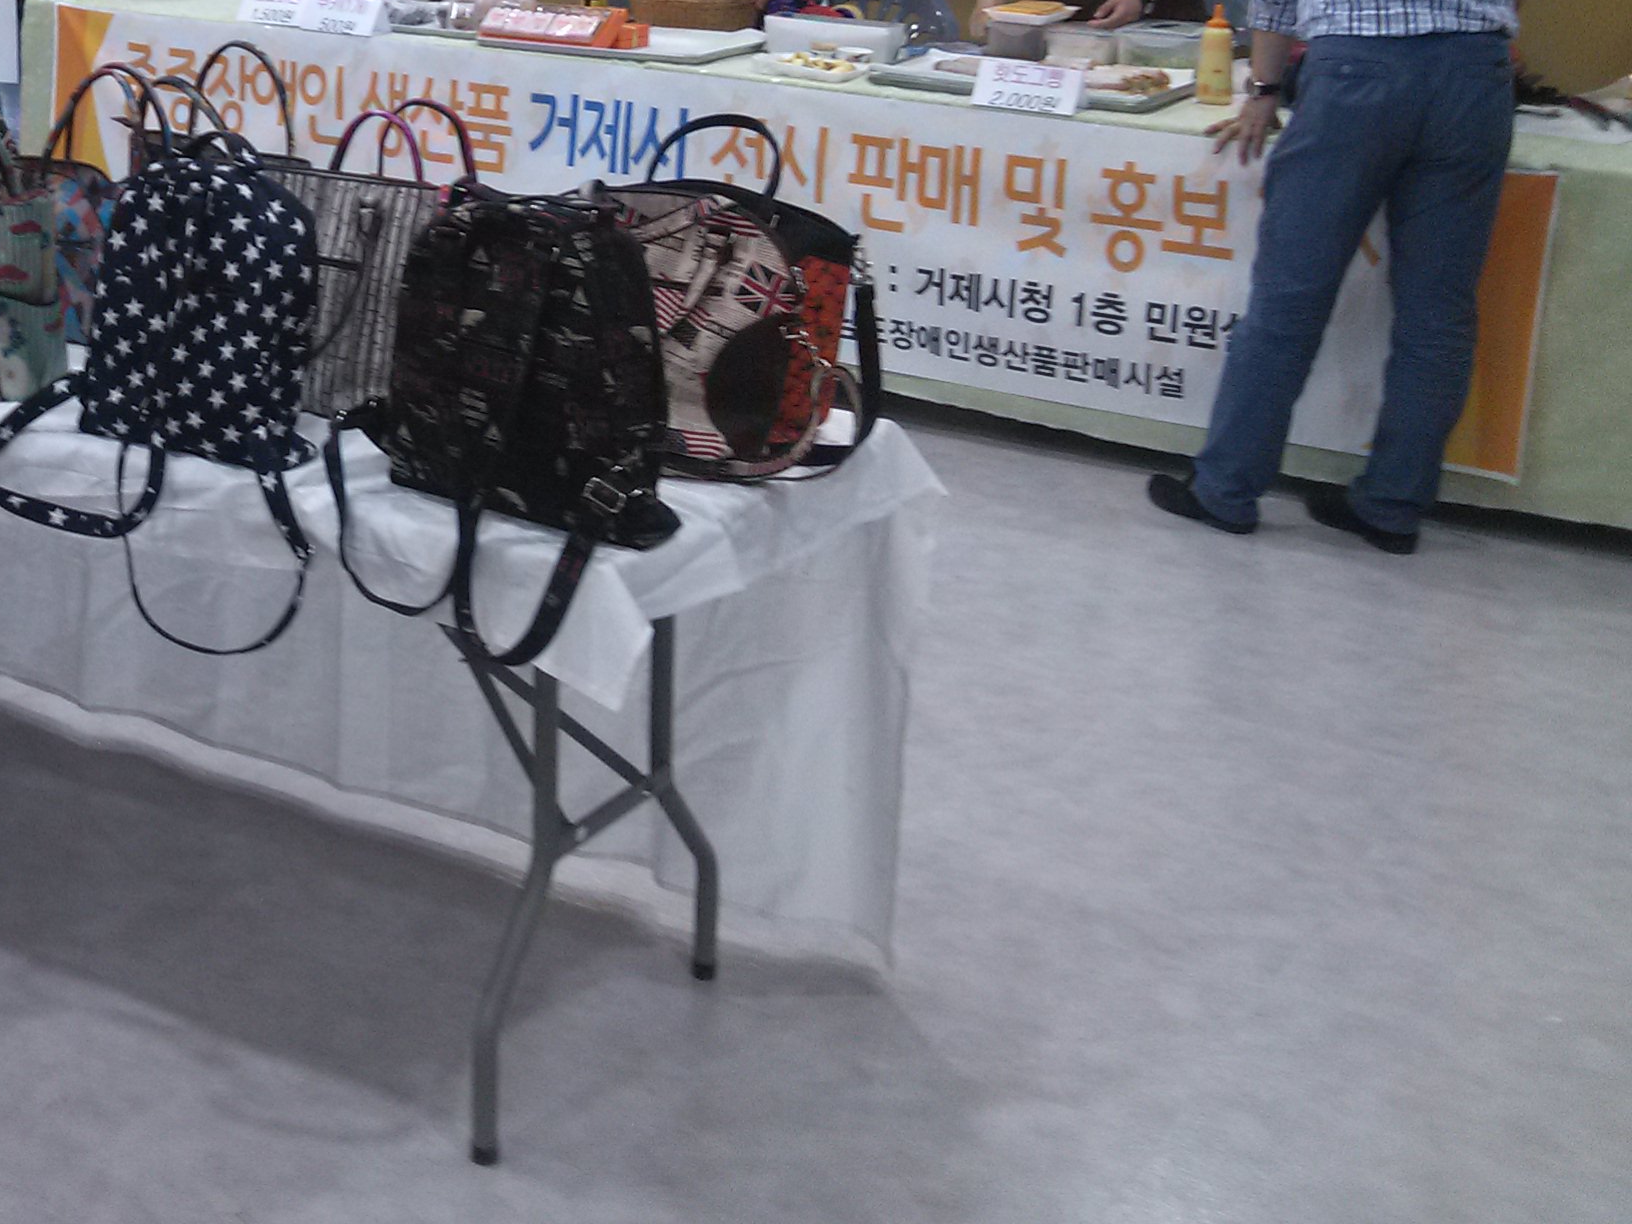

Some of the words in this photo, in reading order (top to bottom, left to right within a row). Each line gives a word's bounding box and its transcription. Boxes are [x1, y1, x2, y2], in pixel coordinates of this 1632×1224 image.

[528, 92, 689, 180] 거제시
[847, 132, 982, 234] 판매
[1004, 153, 1067, 258] 및
[1090, 160, 1234, 273] 홍보
[914, 266, 1055, 325] 거제시청
[1071, 290, 1129, 337] 1층
[1145, 300, 1240, 351] 민원
